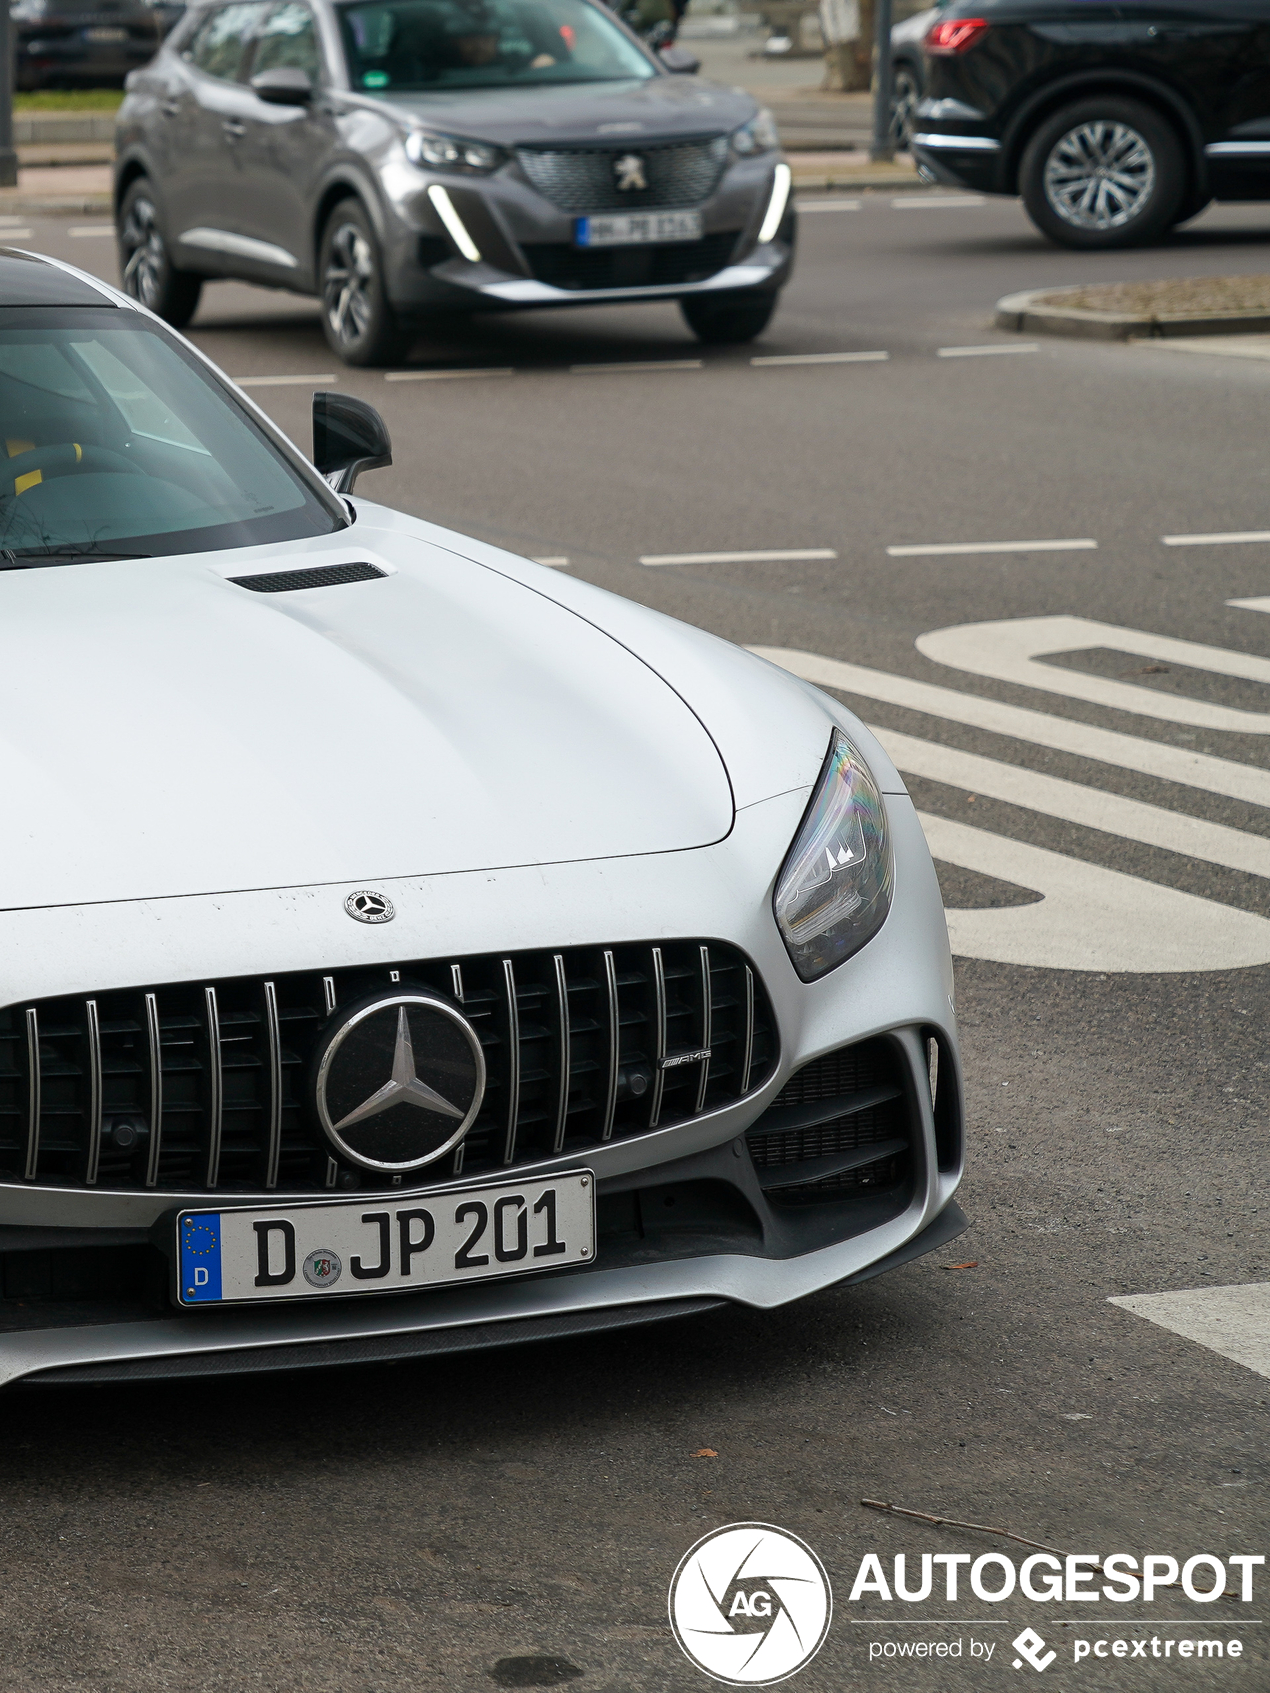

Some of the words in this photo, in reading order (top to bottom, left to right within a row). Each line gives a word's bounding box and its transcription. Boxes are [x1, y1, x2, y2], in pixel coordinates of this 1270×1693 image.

[253, 1220, 295, 1287] D
[350, 1209, 434, 1279] JP
[455, 1190, 566, 1269] 201
[195, 1268, 209, 1287] D
